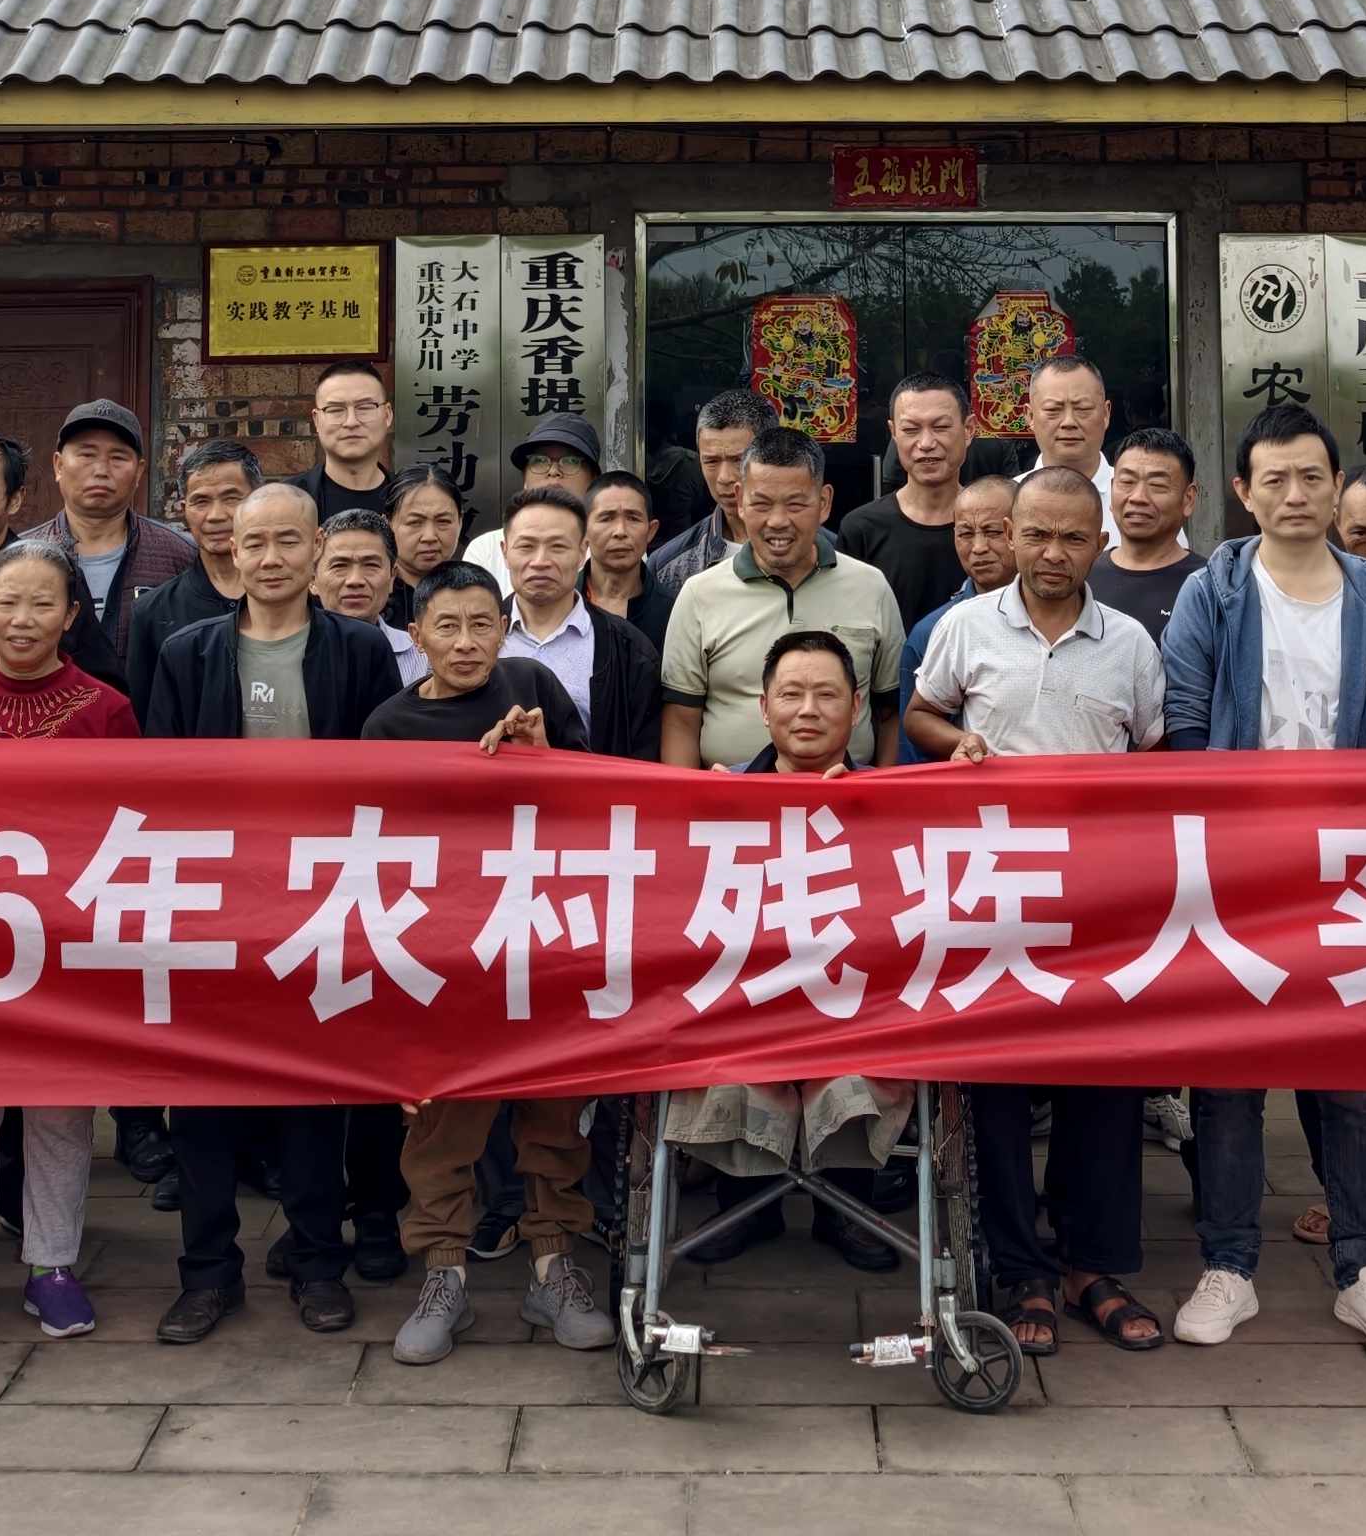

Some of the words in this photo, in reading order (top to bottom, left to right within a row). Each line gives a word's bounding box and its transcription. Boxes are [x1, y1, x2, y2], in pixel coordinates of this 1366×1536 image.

[226, 300, 361, 322] 实践教学基地
[416, 261, 446, 371] 重庆市合川
[450, 260, 480, 371] 大石中学
[1242, 361, 1312, 406] 农
[415, 385, 481, 542] 劳动
